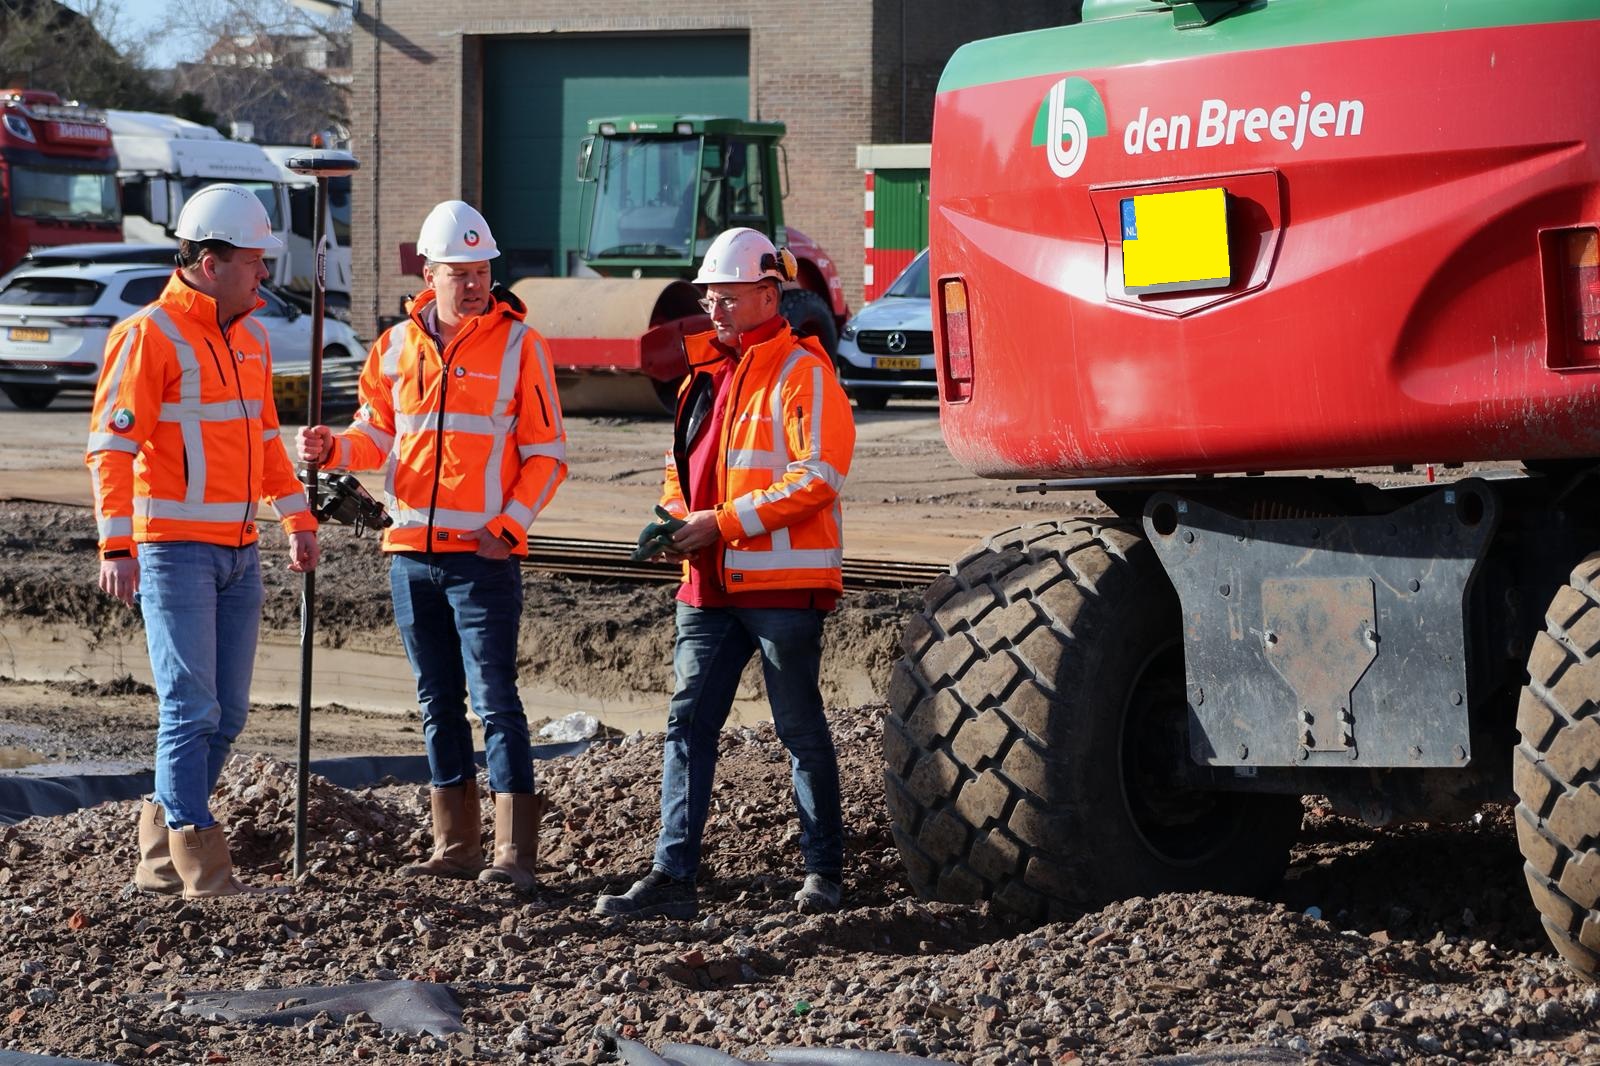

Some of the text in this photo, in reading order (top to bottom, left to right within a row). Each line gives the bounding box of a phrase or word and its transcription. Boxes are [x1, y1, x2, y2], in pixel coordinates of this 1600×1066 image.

[1046, 78, 1089, 179] b
[1123, 90, 1365, 156] den Breejen
[1125, 226, 1137, 237] NL
